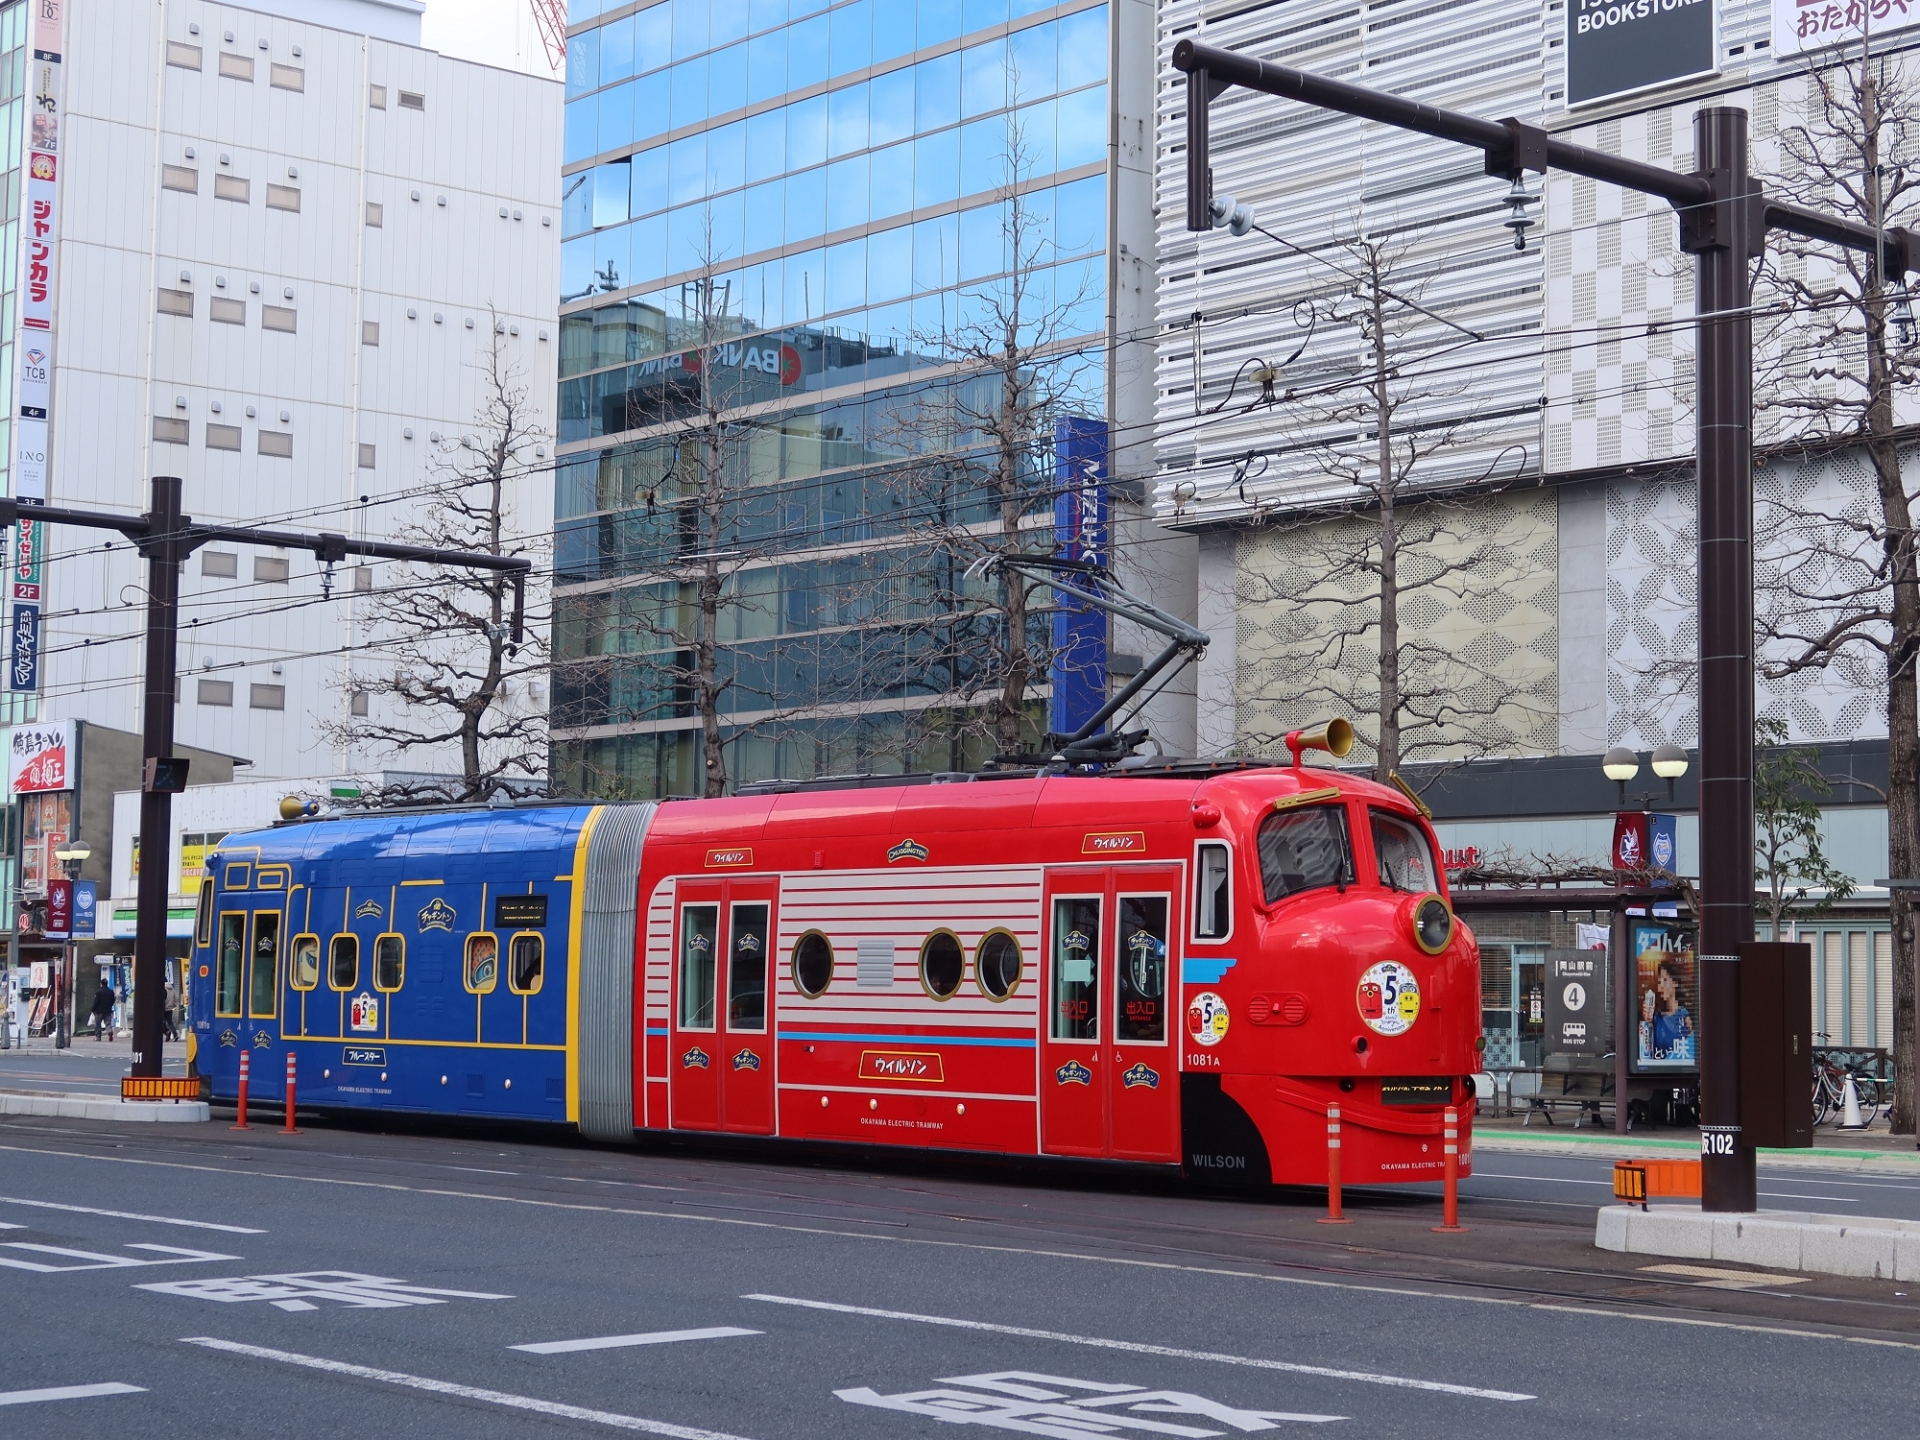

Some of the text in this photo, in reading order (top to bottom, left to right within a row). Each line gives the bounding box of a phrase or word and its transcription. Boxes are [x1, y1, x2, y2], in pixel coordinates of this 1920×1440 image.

[1577, 0, 1704, 34] BOOKSTO
[44, 139, 56, 149] 7F
[30, 200, 51, 303] ジャンカラ
[25, 366, 46, 380] TCB
[28, 408, 39, 417] 4F
[18, 518, 33, 579] サイゼリヤ
[18, 585, 35, 598] 2F
[421, 910, 452, 924] チャギントン
[1560, 961, 1594, 971] 岡山駅前
[1384, 975, 1397, 1005] 5
[1568, 987, 1579, 1006] 4
[1061, 1000, 1088, 1014] 出入口
[1126, 1001, 1155, 1015] 出入口
[1203, 1002, 1213, 1024] 5
[348, 1050, 380, 1062] ブルースター
[1187, 1053, 1221, 1067] 1081A
[1060, 1068, 1089, 1079] チャギントン
[1126, 1071, 1156, 1082] チャギントン
[337, 1085, 355, 1093] OKAYAMA
[355, 1086, 374, 1094] ELECTRIC
[860, 1117, 944, 1129] OKAYAMA ELECTRIC TRAMWAY
[1192, 1154, 1245, 1168] WILSON
[1411, 1161, 1436, 1169] ELECTRIC
